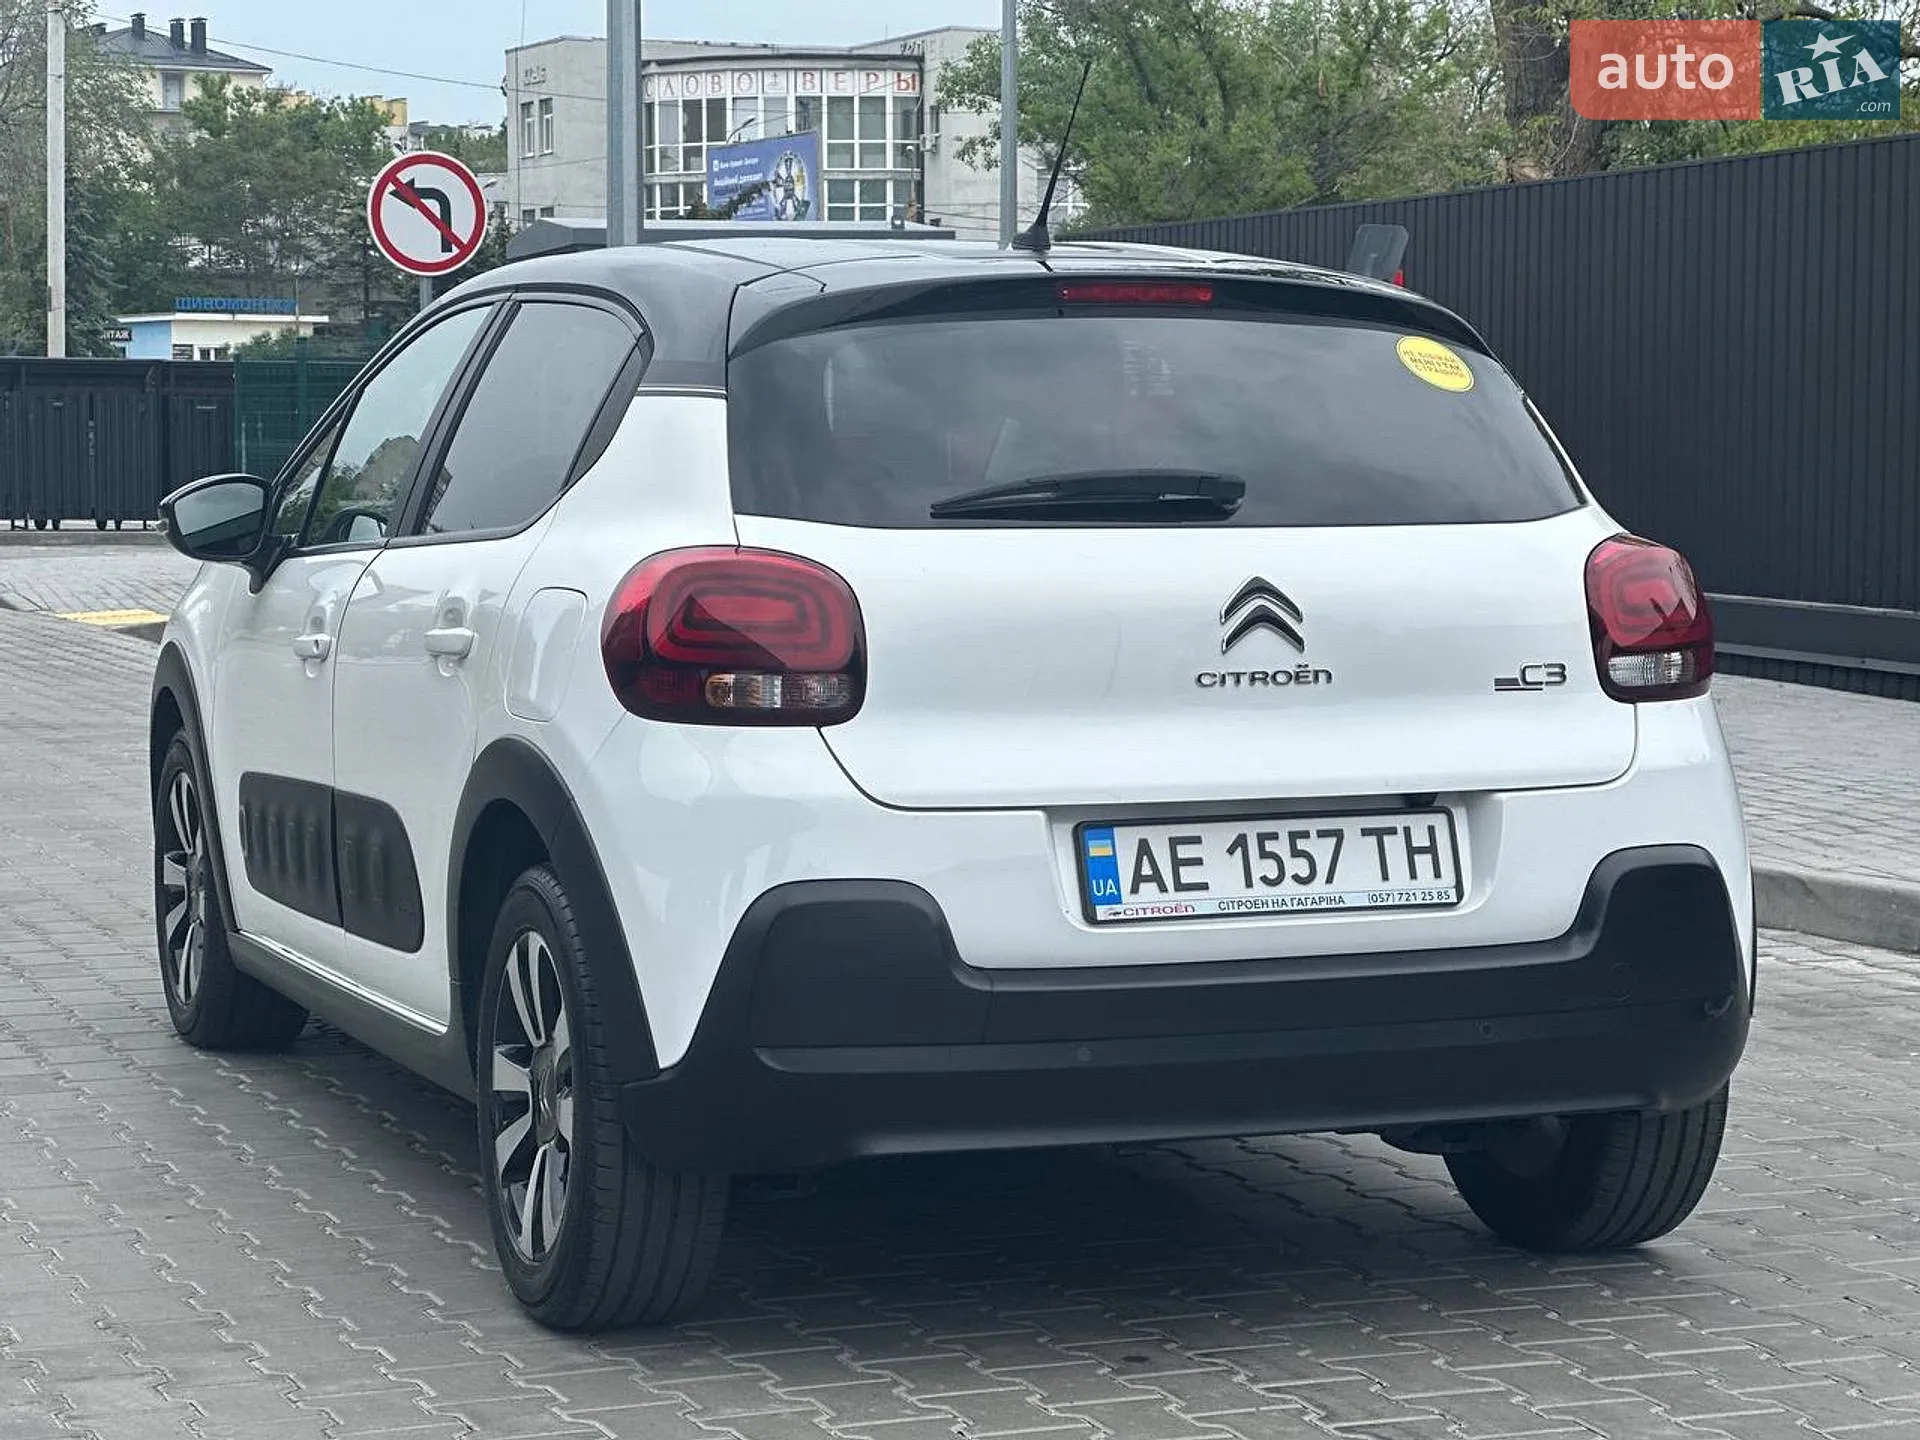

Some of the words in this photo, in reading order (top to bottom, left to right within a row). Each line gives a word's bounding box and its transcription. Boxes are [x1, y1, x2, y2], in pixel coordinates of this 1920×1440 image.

[643, 71, 752, 97] СЛОВО
[801, 71, 917, 92] ВЕРЫ
[1519, 662, 1568, 688] C3
[1129, 835, 1210, 895] AE
[1225, 828, 1345, 889] 1557
[1360, 824, 1442, 882] TH
[1092, 878, 1118, 897] UA
[1399, 890, 1418, 903] 721
[1421, 889, 1434, 902] 25
[1437, 888, 1451, 901] 85
[1272, 897, 1288, 909] НА
[1290, 894, 1346, 908] ГАГАРІНА
